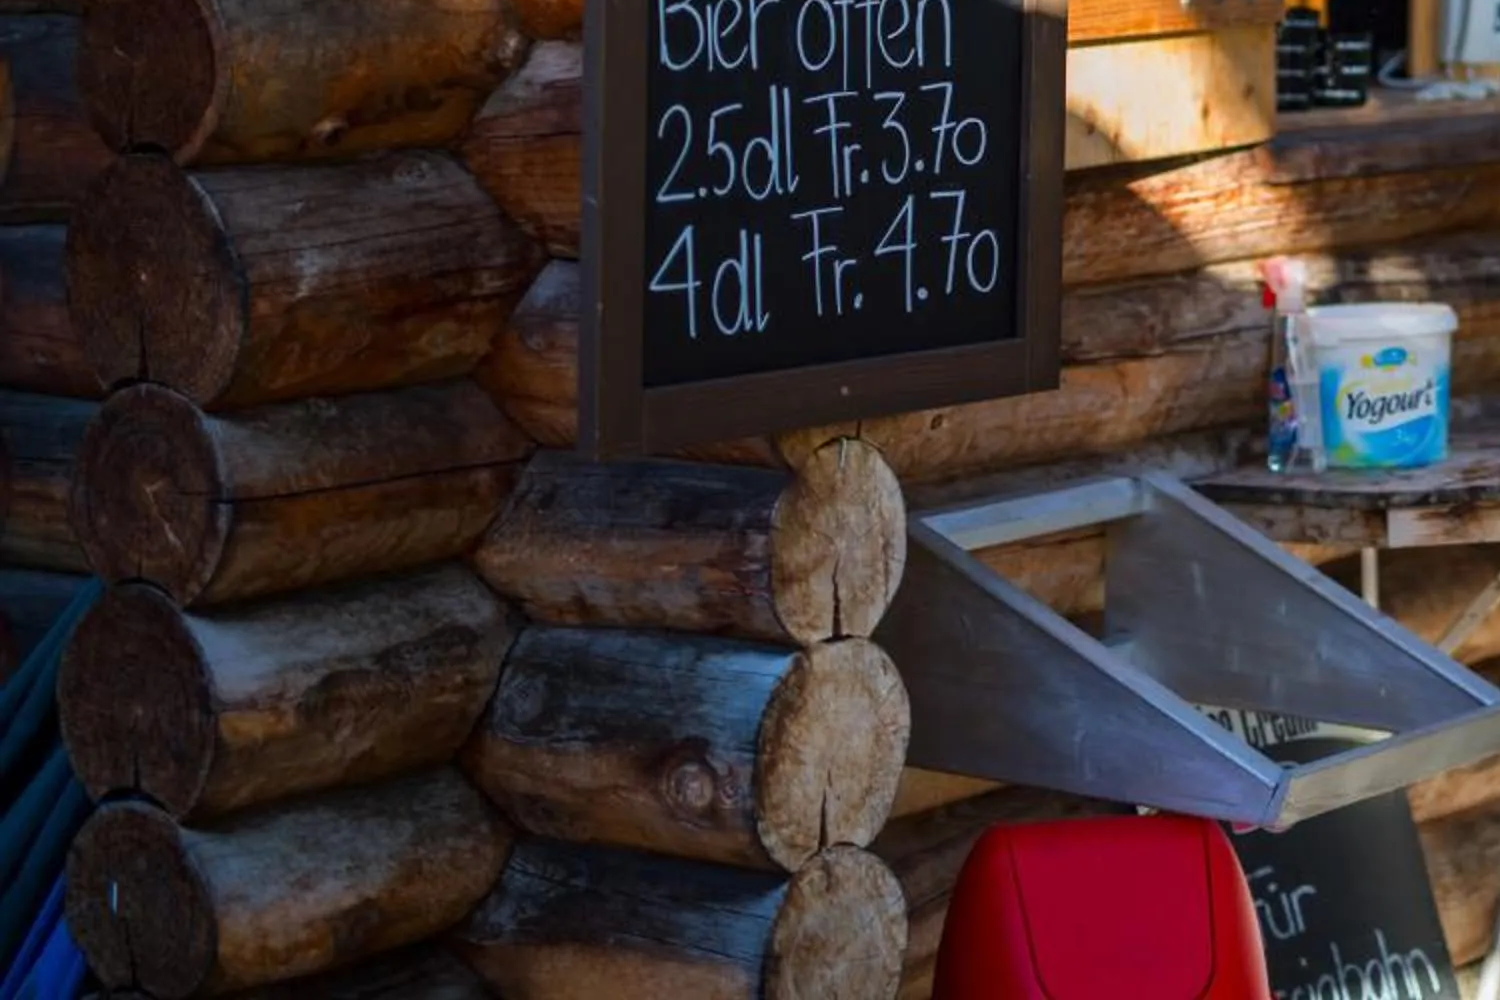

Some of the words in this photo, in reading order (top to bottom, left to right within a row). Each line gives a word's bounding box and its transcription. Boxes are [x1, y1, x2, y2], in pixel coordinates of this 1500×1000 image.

[790, 206, 864, 317] Fr.
[874, 189, 999, 313] 4.70
[1346, 380, 1435, 425] Yogourt
